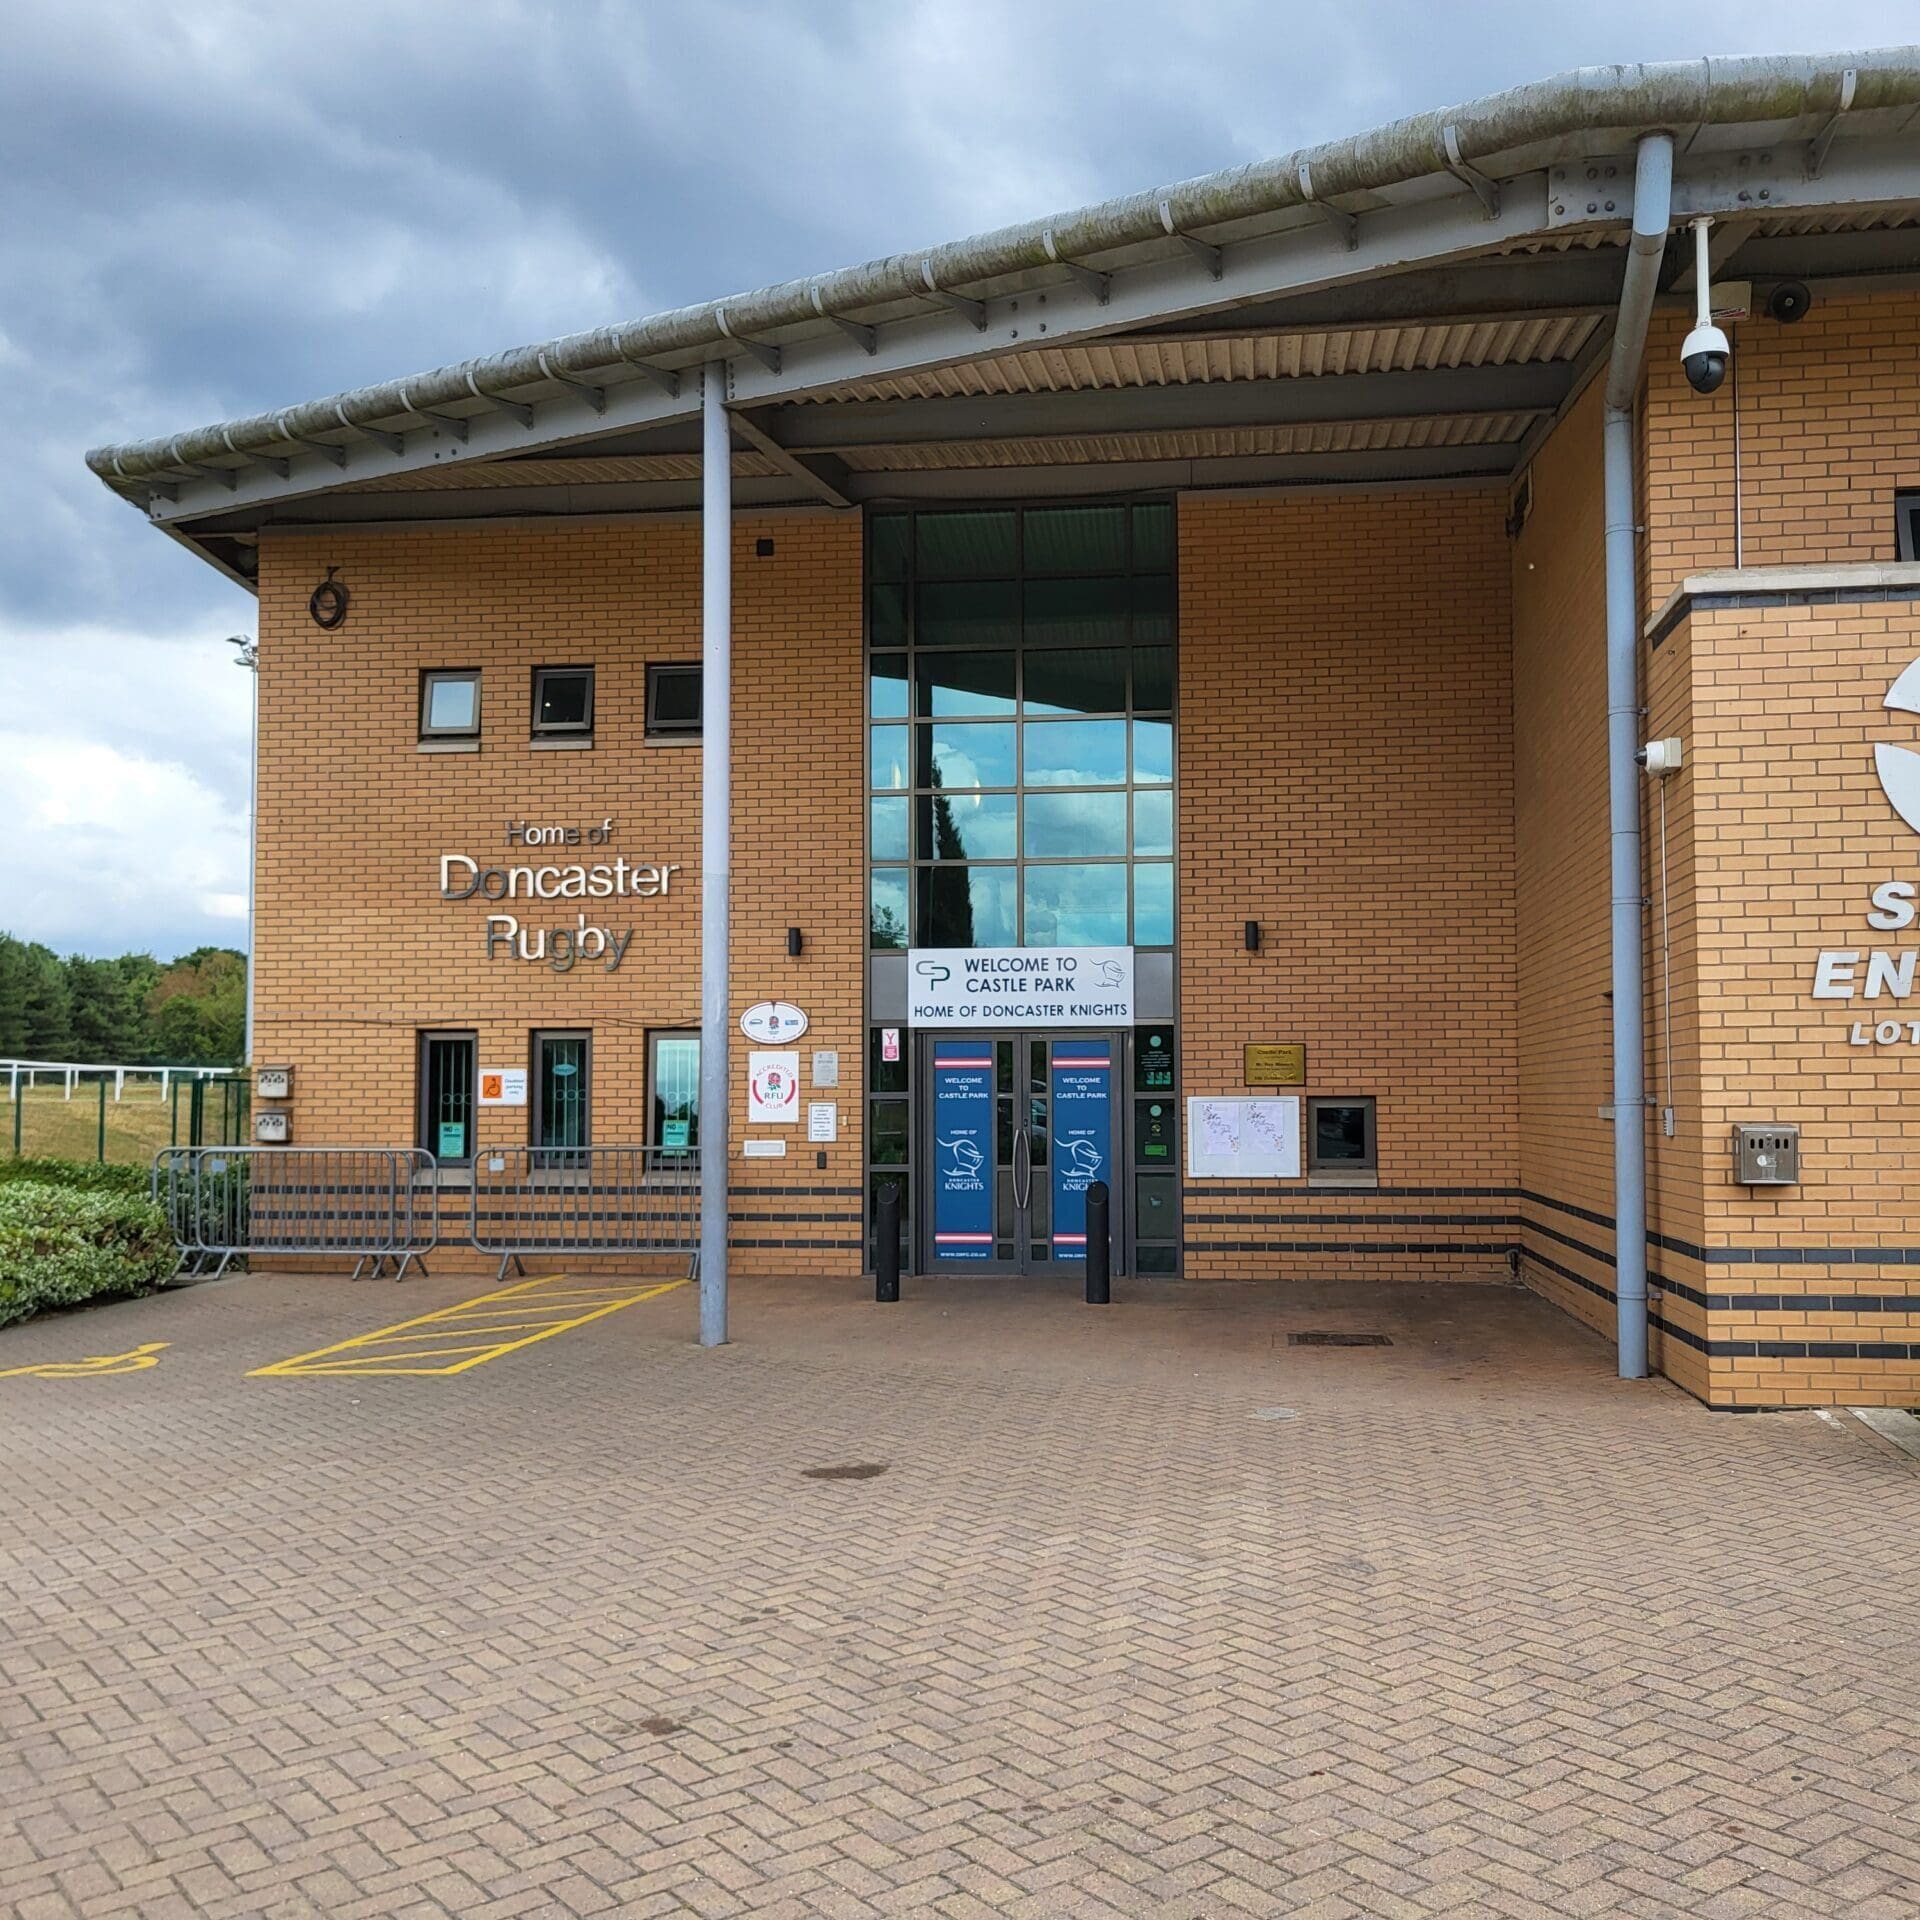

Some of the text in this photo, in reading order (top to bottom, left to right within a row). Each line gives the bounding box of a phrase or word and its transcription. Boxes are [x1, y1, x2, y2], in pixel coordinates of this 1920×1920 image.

[506, 818, 612, 845] Home of
[440, 854, 681, 900] Doncaster
[1867, 881, 1920, 930] S
[486, 913, 634, 972] Rugby
[965, 957, 1078, 973] WELCOME TO
[1812, 951, 1918, 999] EN
[966, 977, 1076, 993] CASTLE PARK
[914, 1003, 1127, 1018] HOME OF DONCASTER KNIGHTS
[764, 1092, 784, 1100] RFU
[945, 1182, 984, 1191] KNIGHTS
